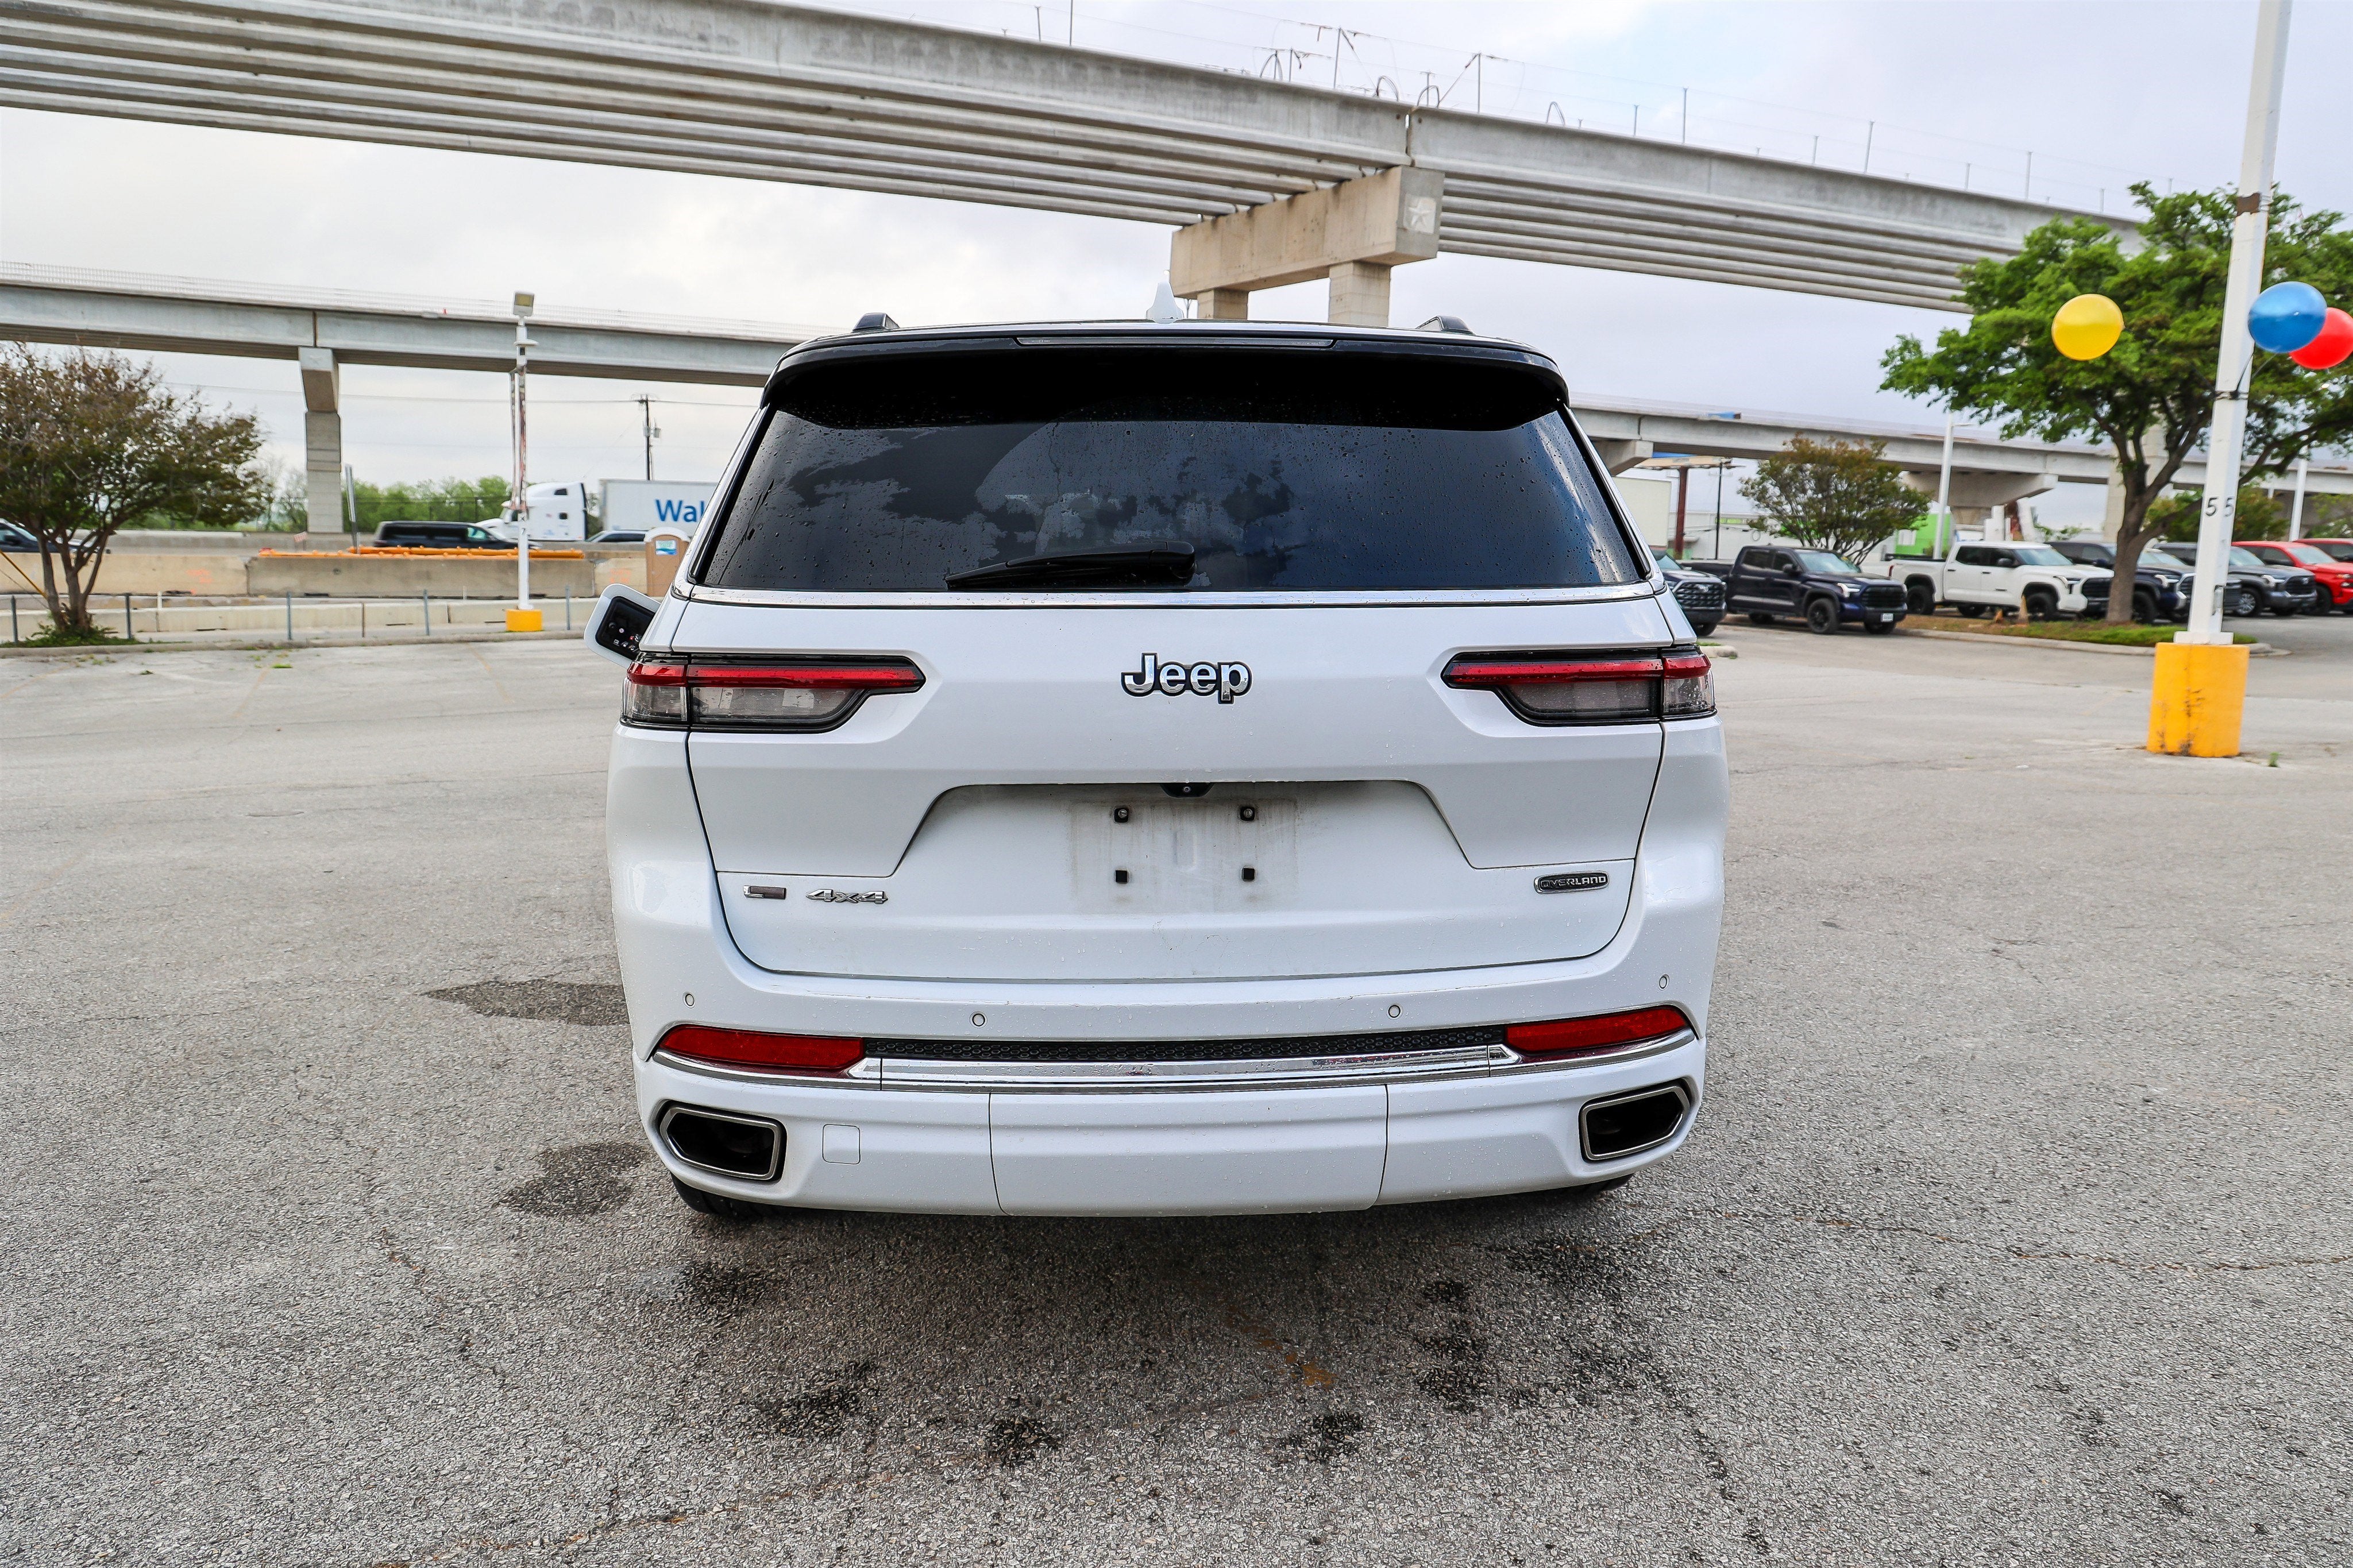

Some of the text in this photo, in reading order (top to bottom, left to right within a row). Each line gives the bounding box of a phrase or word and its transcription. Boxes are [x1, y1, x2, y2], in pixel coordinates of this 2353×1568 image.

[1121, 652, 1253, 705] Jeep
[1541, 876, 1606, 887] OVERLAND
[805, 889, 889, 904] 4x4
